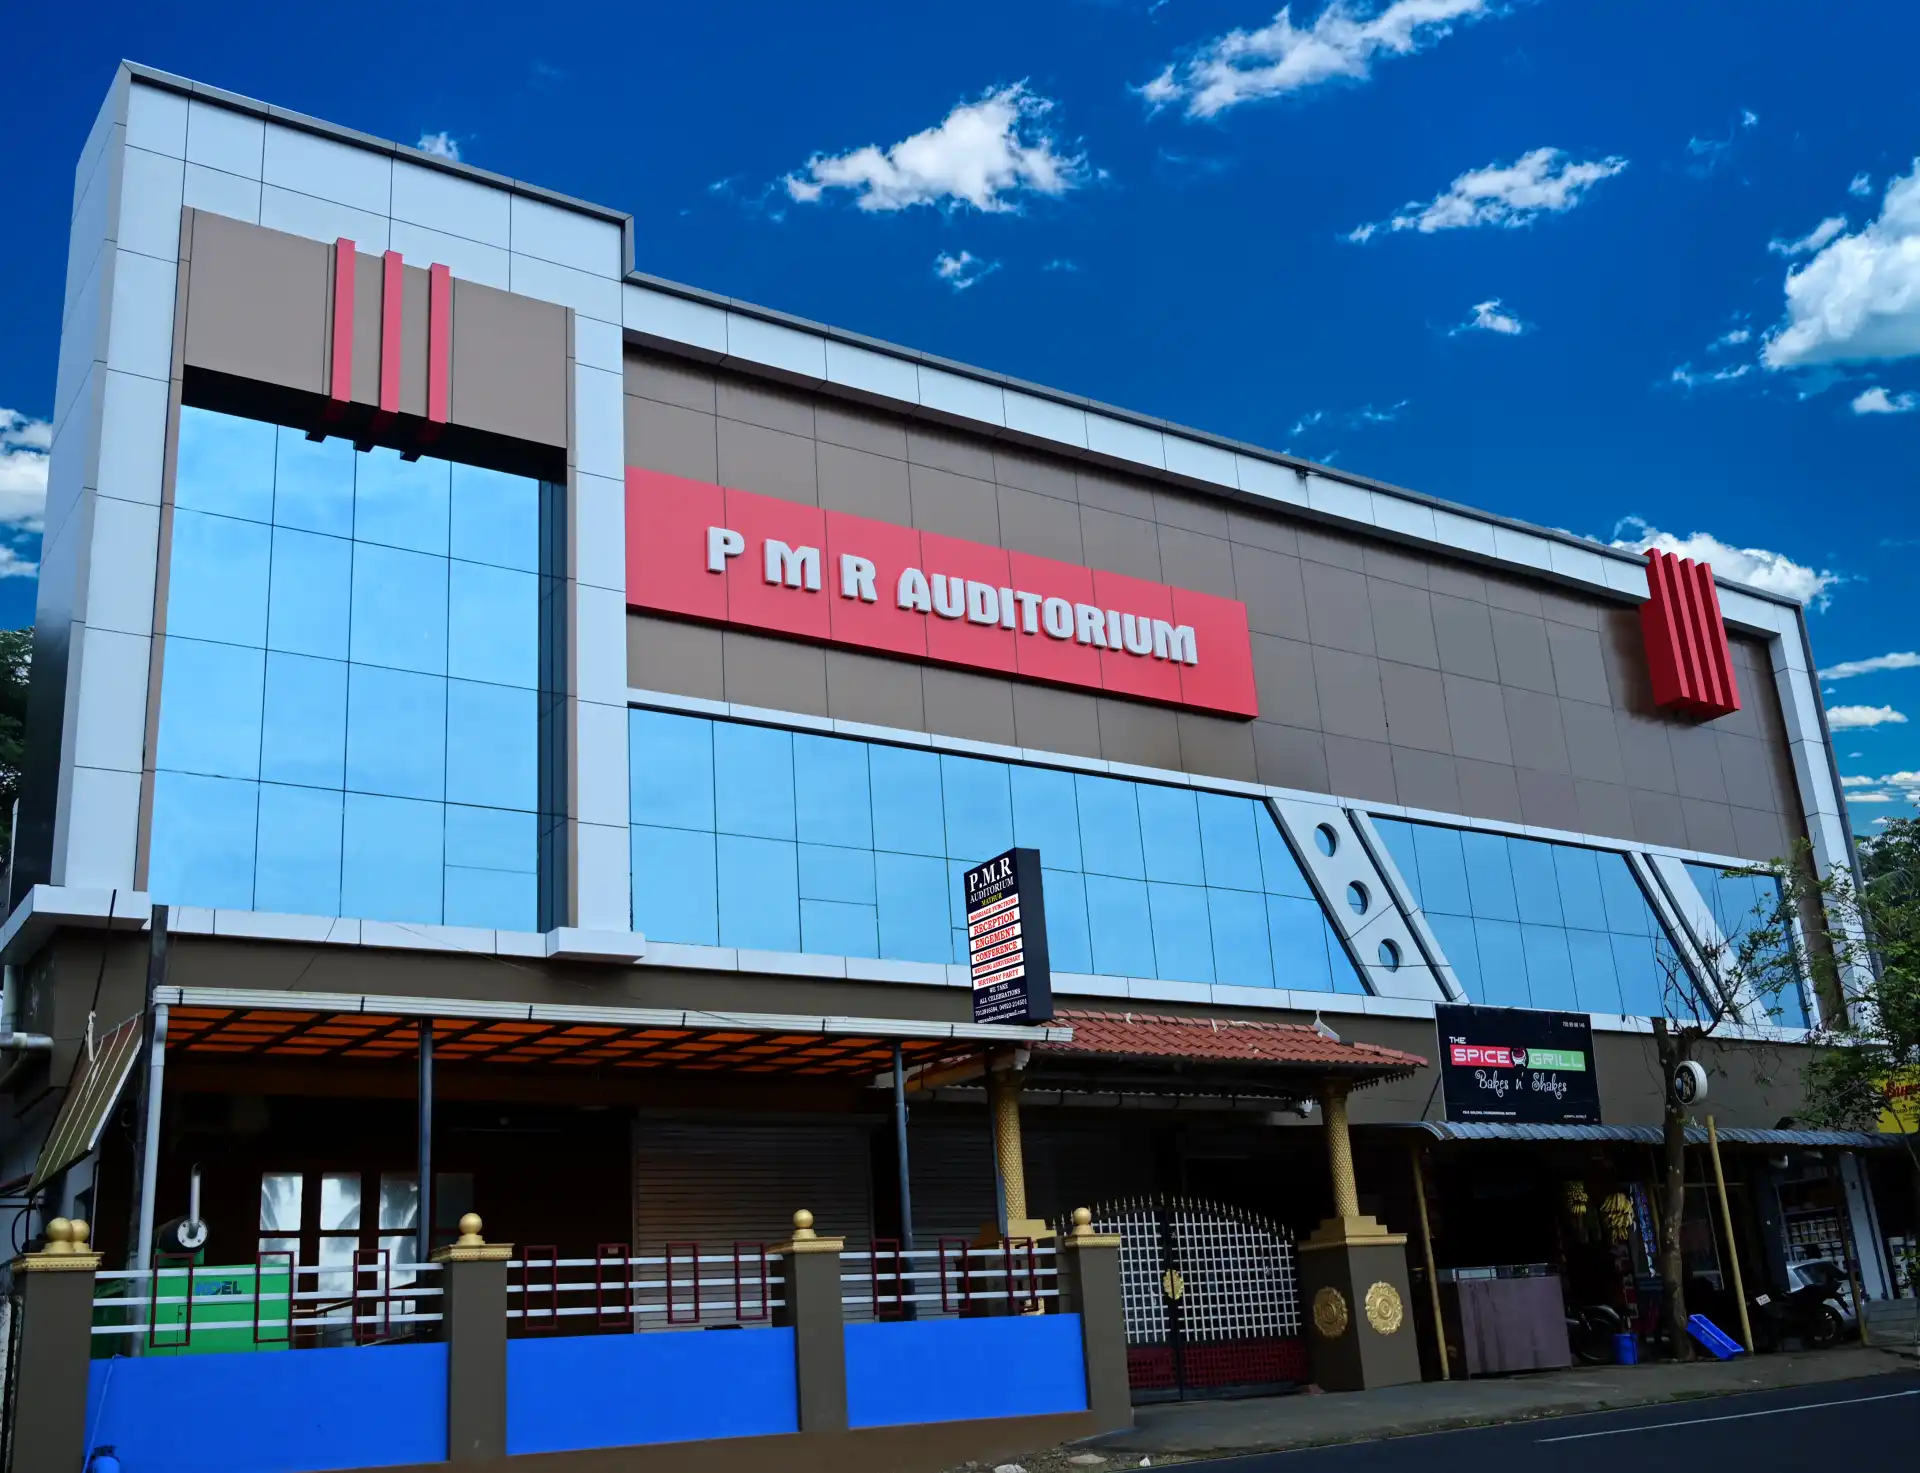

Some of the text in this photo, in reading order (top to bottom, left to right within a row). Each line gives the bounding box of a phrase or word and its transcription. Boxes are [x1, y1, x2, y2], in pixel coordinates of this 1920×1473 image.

[706, 526, 1198, 665] P M R AUDITORIUM
[969, 857, 1013, 892] P.M.R
[970, 876, 1014, 904] AUDITORIUM
[973, 911, 1015, 935] RECEPTION
[975, 926, 1016, 949] ENGEMENT
[975, 941, 1018, 962] CONFERENCE
[978, 969, 1019, 987] BIRTHDAY PARTY
[988, 988, 1021, 1002] CELEBRATIONS
[1449, 1036, 1467, 1044] THE
[1453, 1048, 1584, 1068] SPICE GRILL
[1474, 1069, 1509, 1098] Bakes
[1531, 1072, 1568, 1100] Shakes
